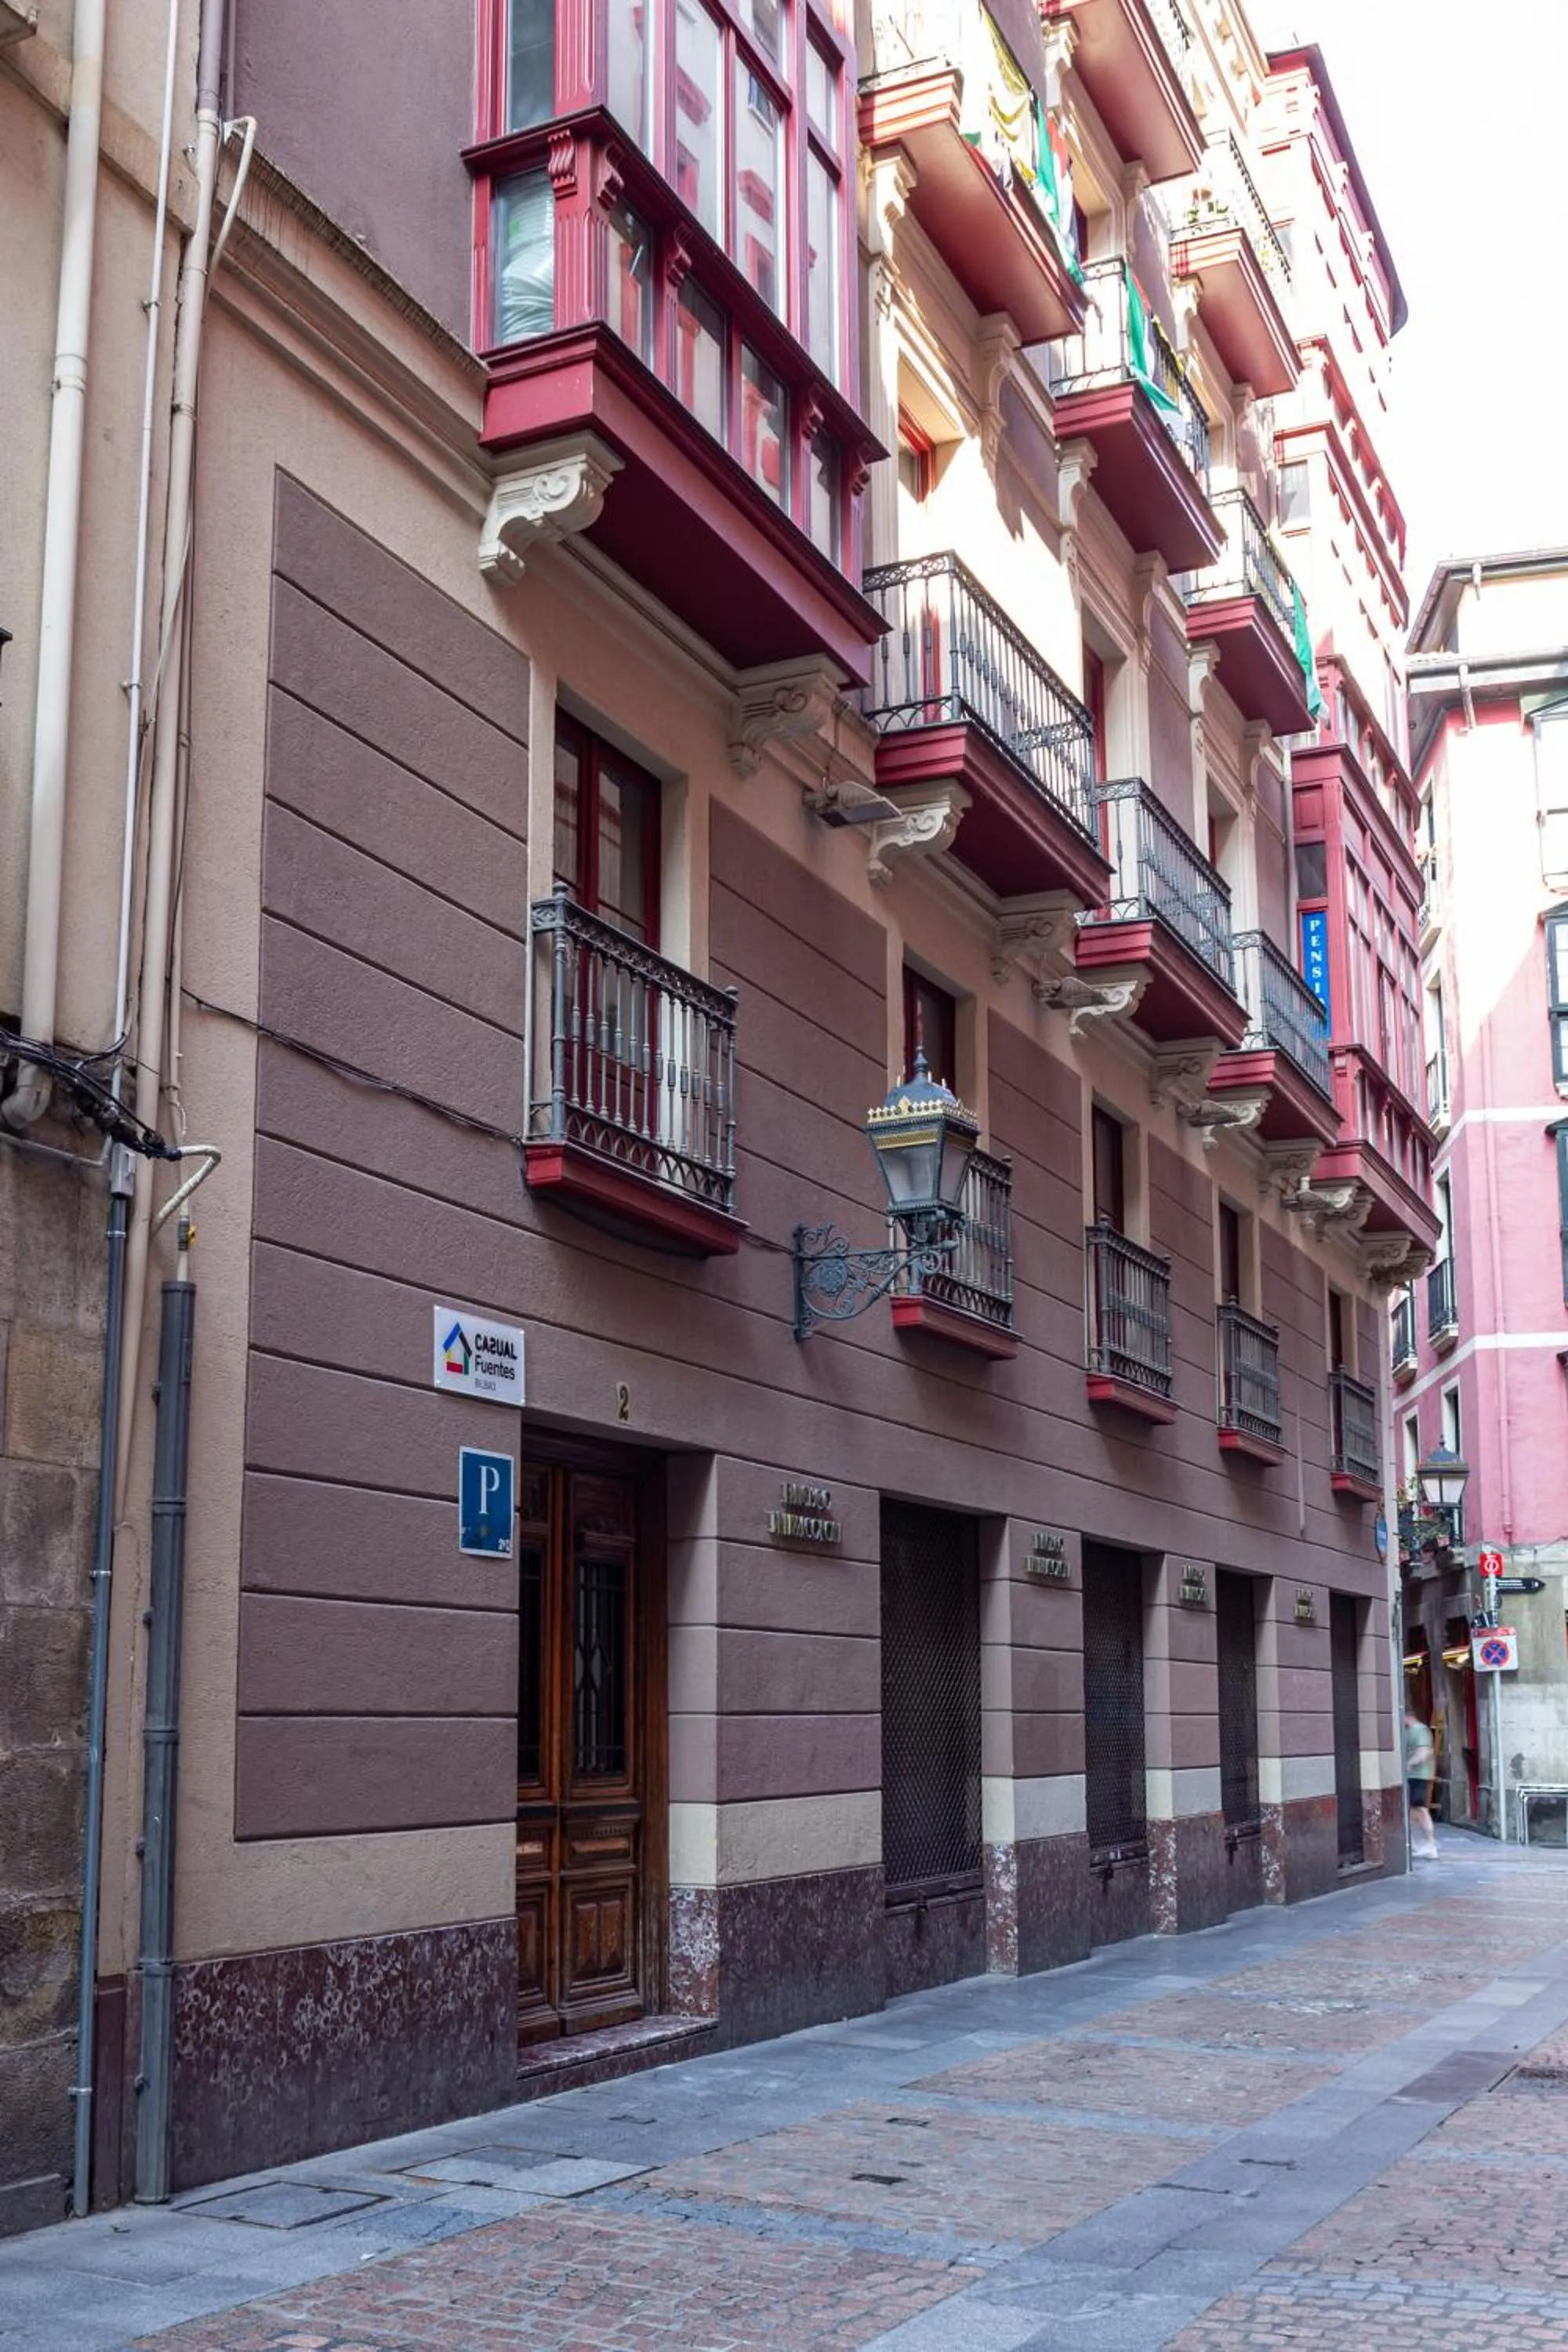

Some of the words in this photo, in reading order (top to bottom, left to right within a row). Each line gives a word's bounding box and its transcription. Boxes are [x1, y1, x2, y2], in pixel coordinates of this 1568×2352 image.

[474, 1334, 517, 1360] CASUAL
[474, 1355, 515, 1381] Fuentes
[618, 1384, 630, 1422] 2
[478, 1465, 500, 1515] P
